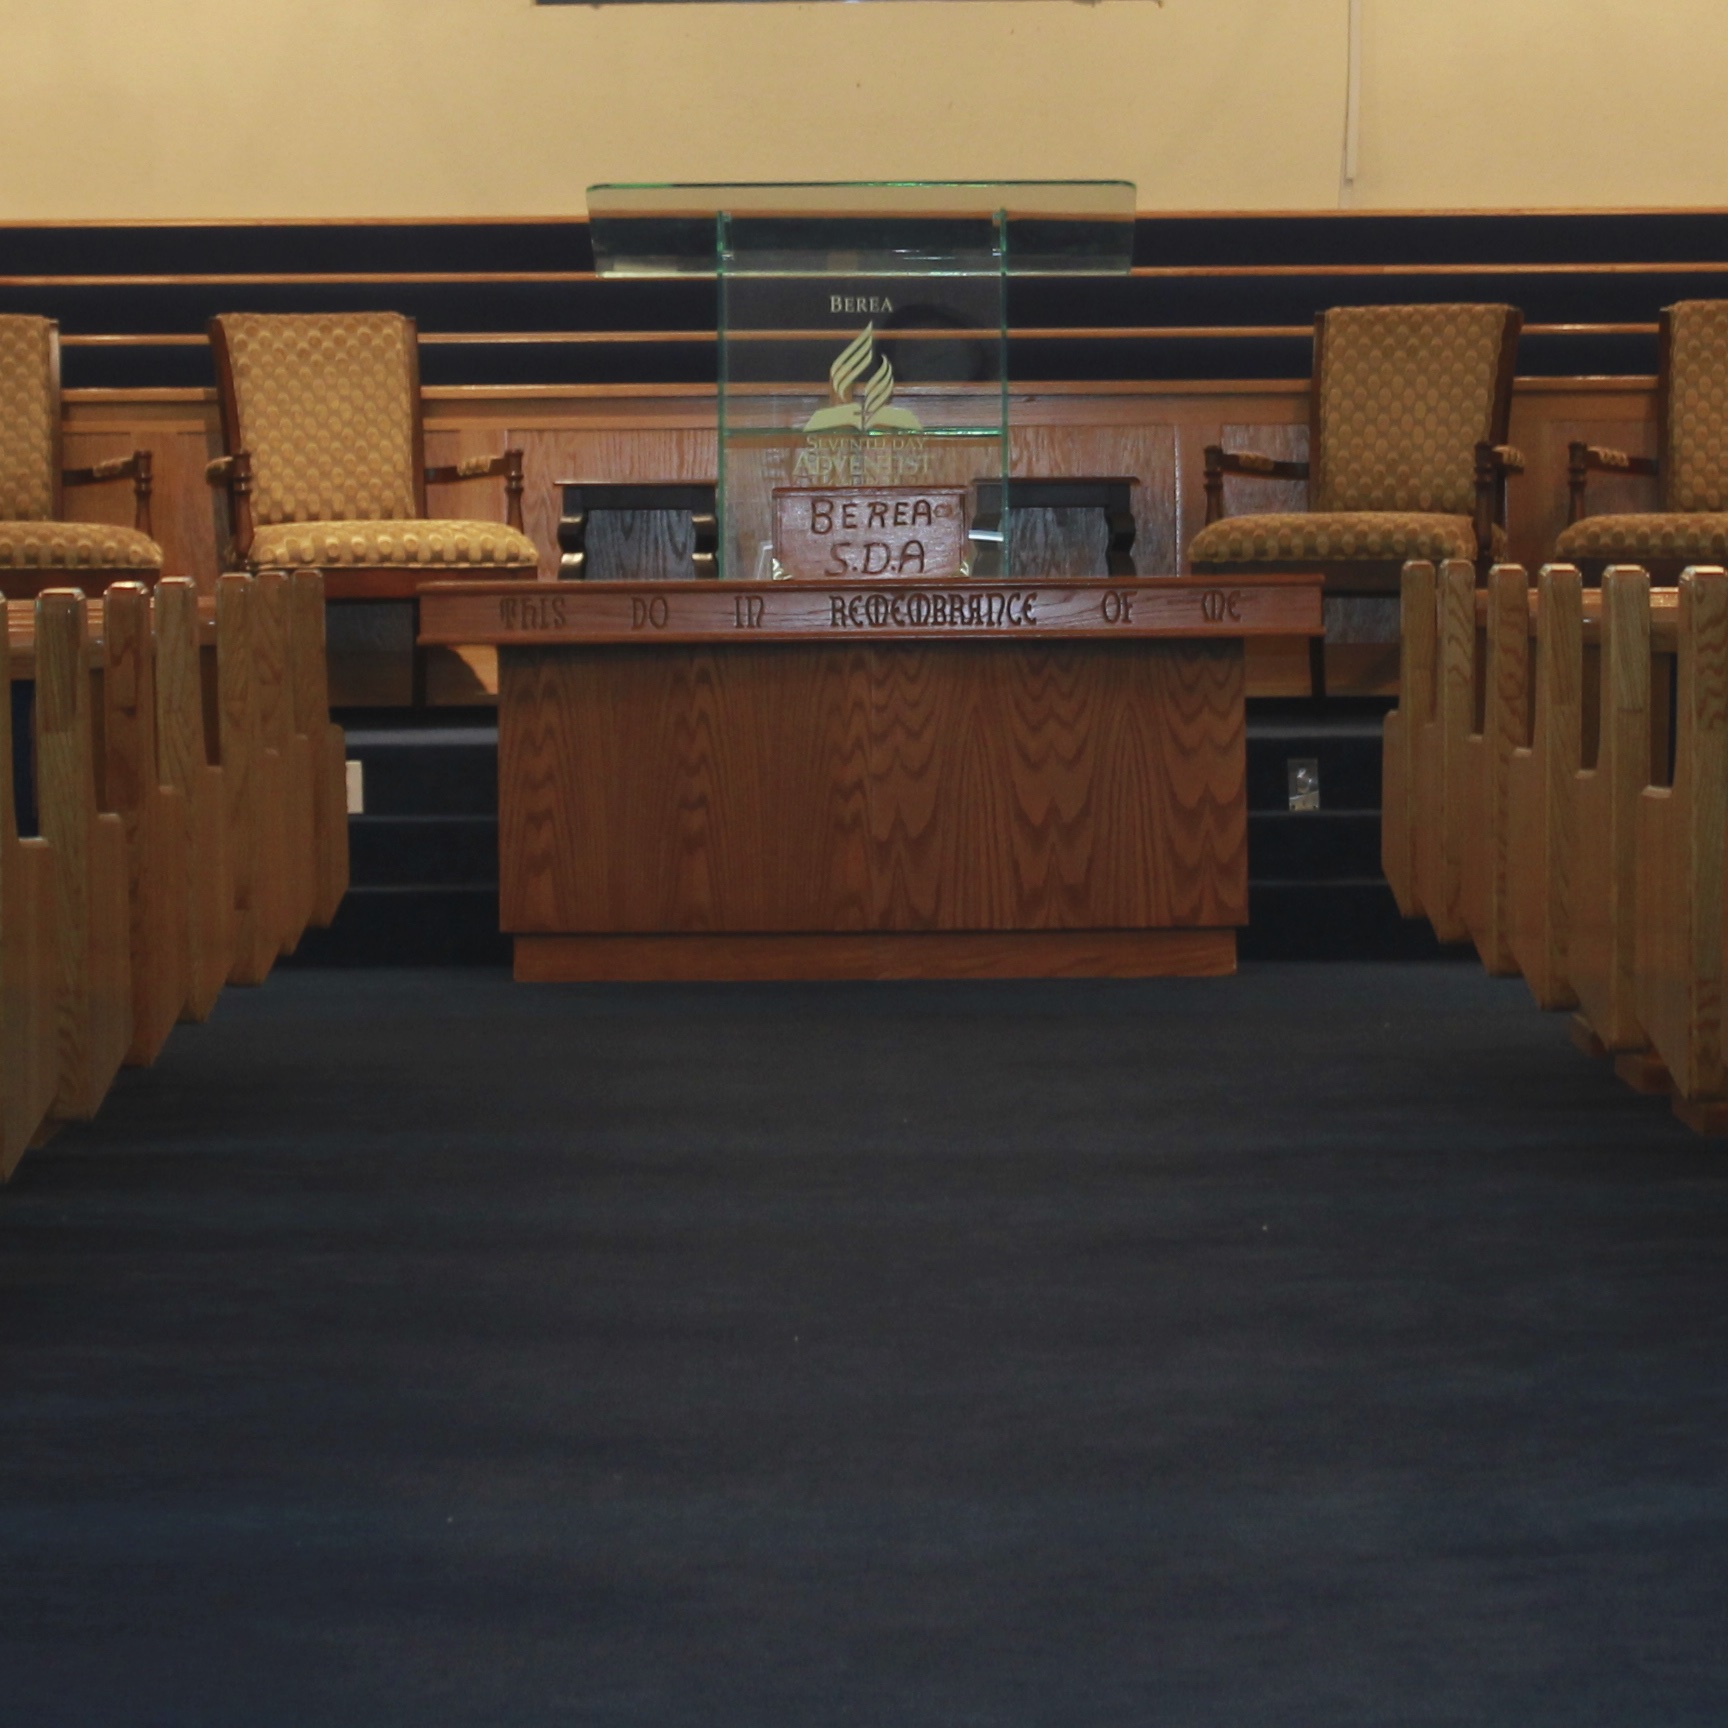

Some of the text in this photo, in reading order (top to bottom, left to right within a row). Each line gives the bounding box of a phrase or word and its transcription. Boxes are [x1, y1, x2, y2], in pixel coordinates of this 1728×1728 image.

[830, 296, 893, 313] BEREA
[893, 438, 926, 450] DAY
[811, 499, 932, 534] BEREA
[632, 596, 670, 630] DO
[734, 595, 764, 629] IN
[830, 592, 1038, 628] REMEMBRANCE
[1100, 590, 1137, 625] OF
[1201, 590, 1242, 623] ME
